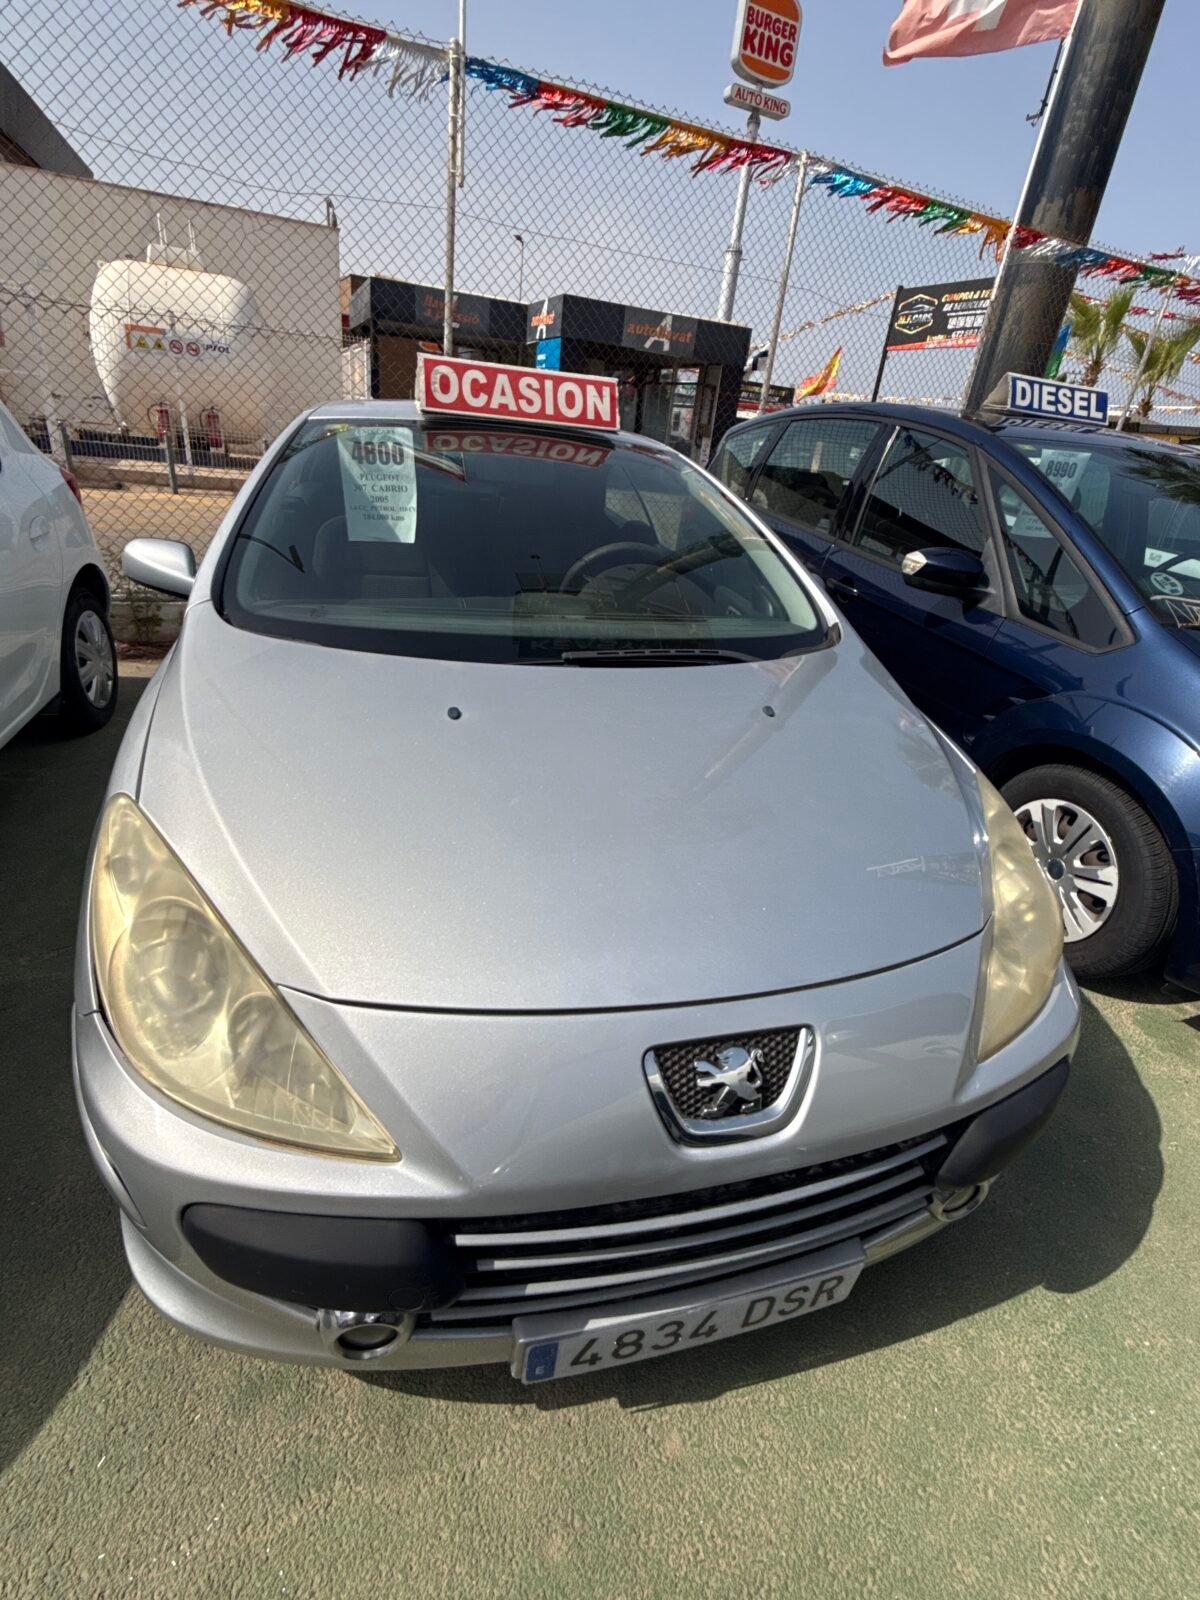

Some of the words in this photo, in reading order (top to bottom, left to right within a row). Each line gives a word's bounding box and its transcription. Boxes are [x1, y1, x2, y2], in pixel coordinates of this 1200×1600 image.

[747, 5, 797, 43] BURGER
[742, 25, 794, 67] KING
[734, 87, 762, 105] AUTO
[763, 96, 787, 114] KING
[430, 364, 611, 422] OCASION
[1015, 379, 1104, 419] DIESEL
[351, 441, 404, 465] 4800
[360, 473, 400, 482] PEUGEOT
[1046, 460, 1078, 479] 8990
[371, 484, 408, 493] CABRIO
[570, 1310, 718, 1368] 4834
[741, 1274, 845, 1329] DSR
